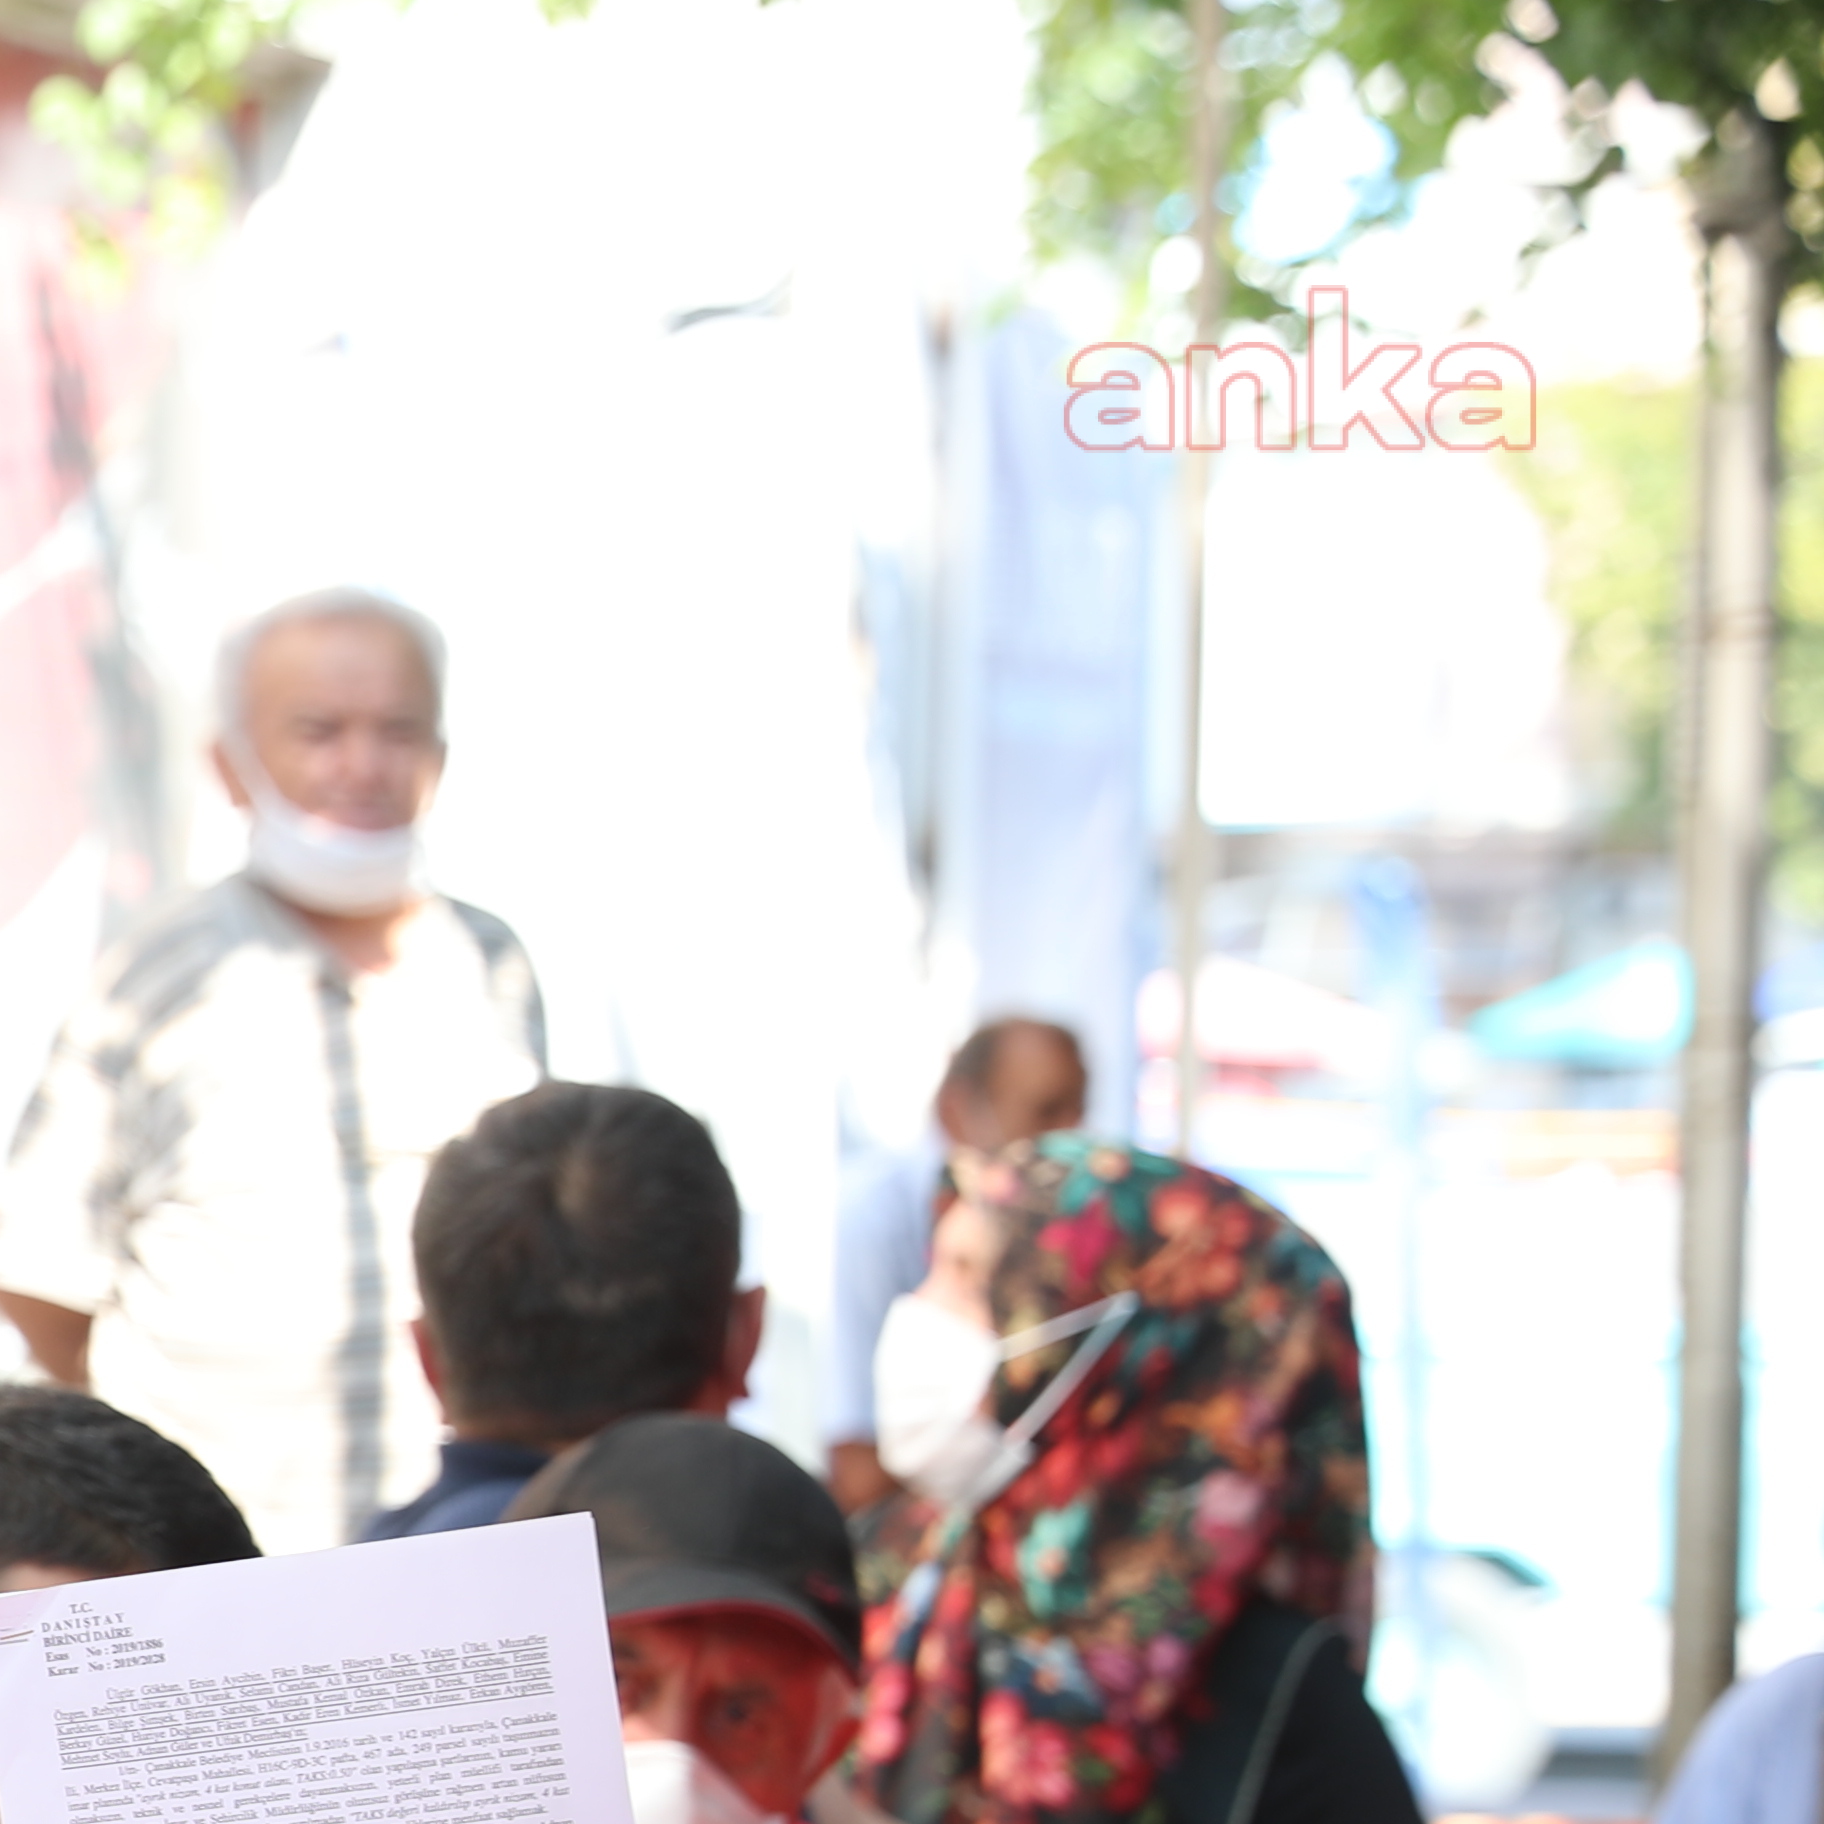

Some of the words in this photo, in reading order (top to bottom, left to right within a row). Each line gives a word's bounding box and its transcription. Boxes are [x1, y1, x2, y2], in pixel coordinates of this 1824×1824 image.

[70, 1602, 93, 1614] T.C.
[44, 1631, 90, 1648] BİRİNCİ
[93, 1627, 132, 1641] DAİRE
[46, 1651, 69, 1662] Esas
[48, 1665, 79, 1677] Karar
